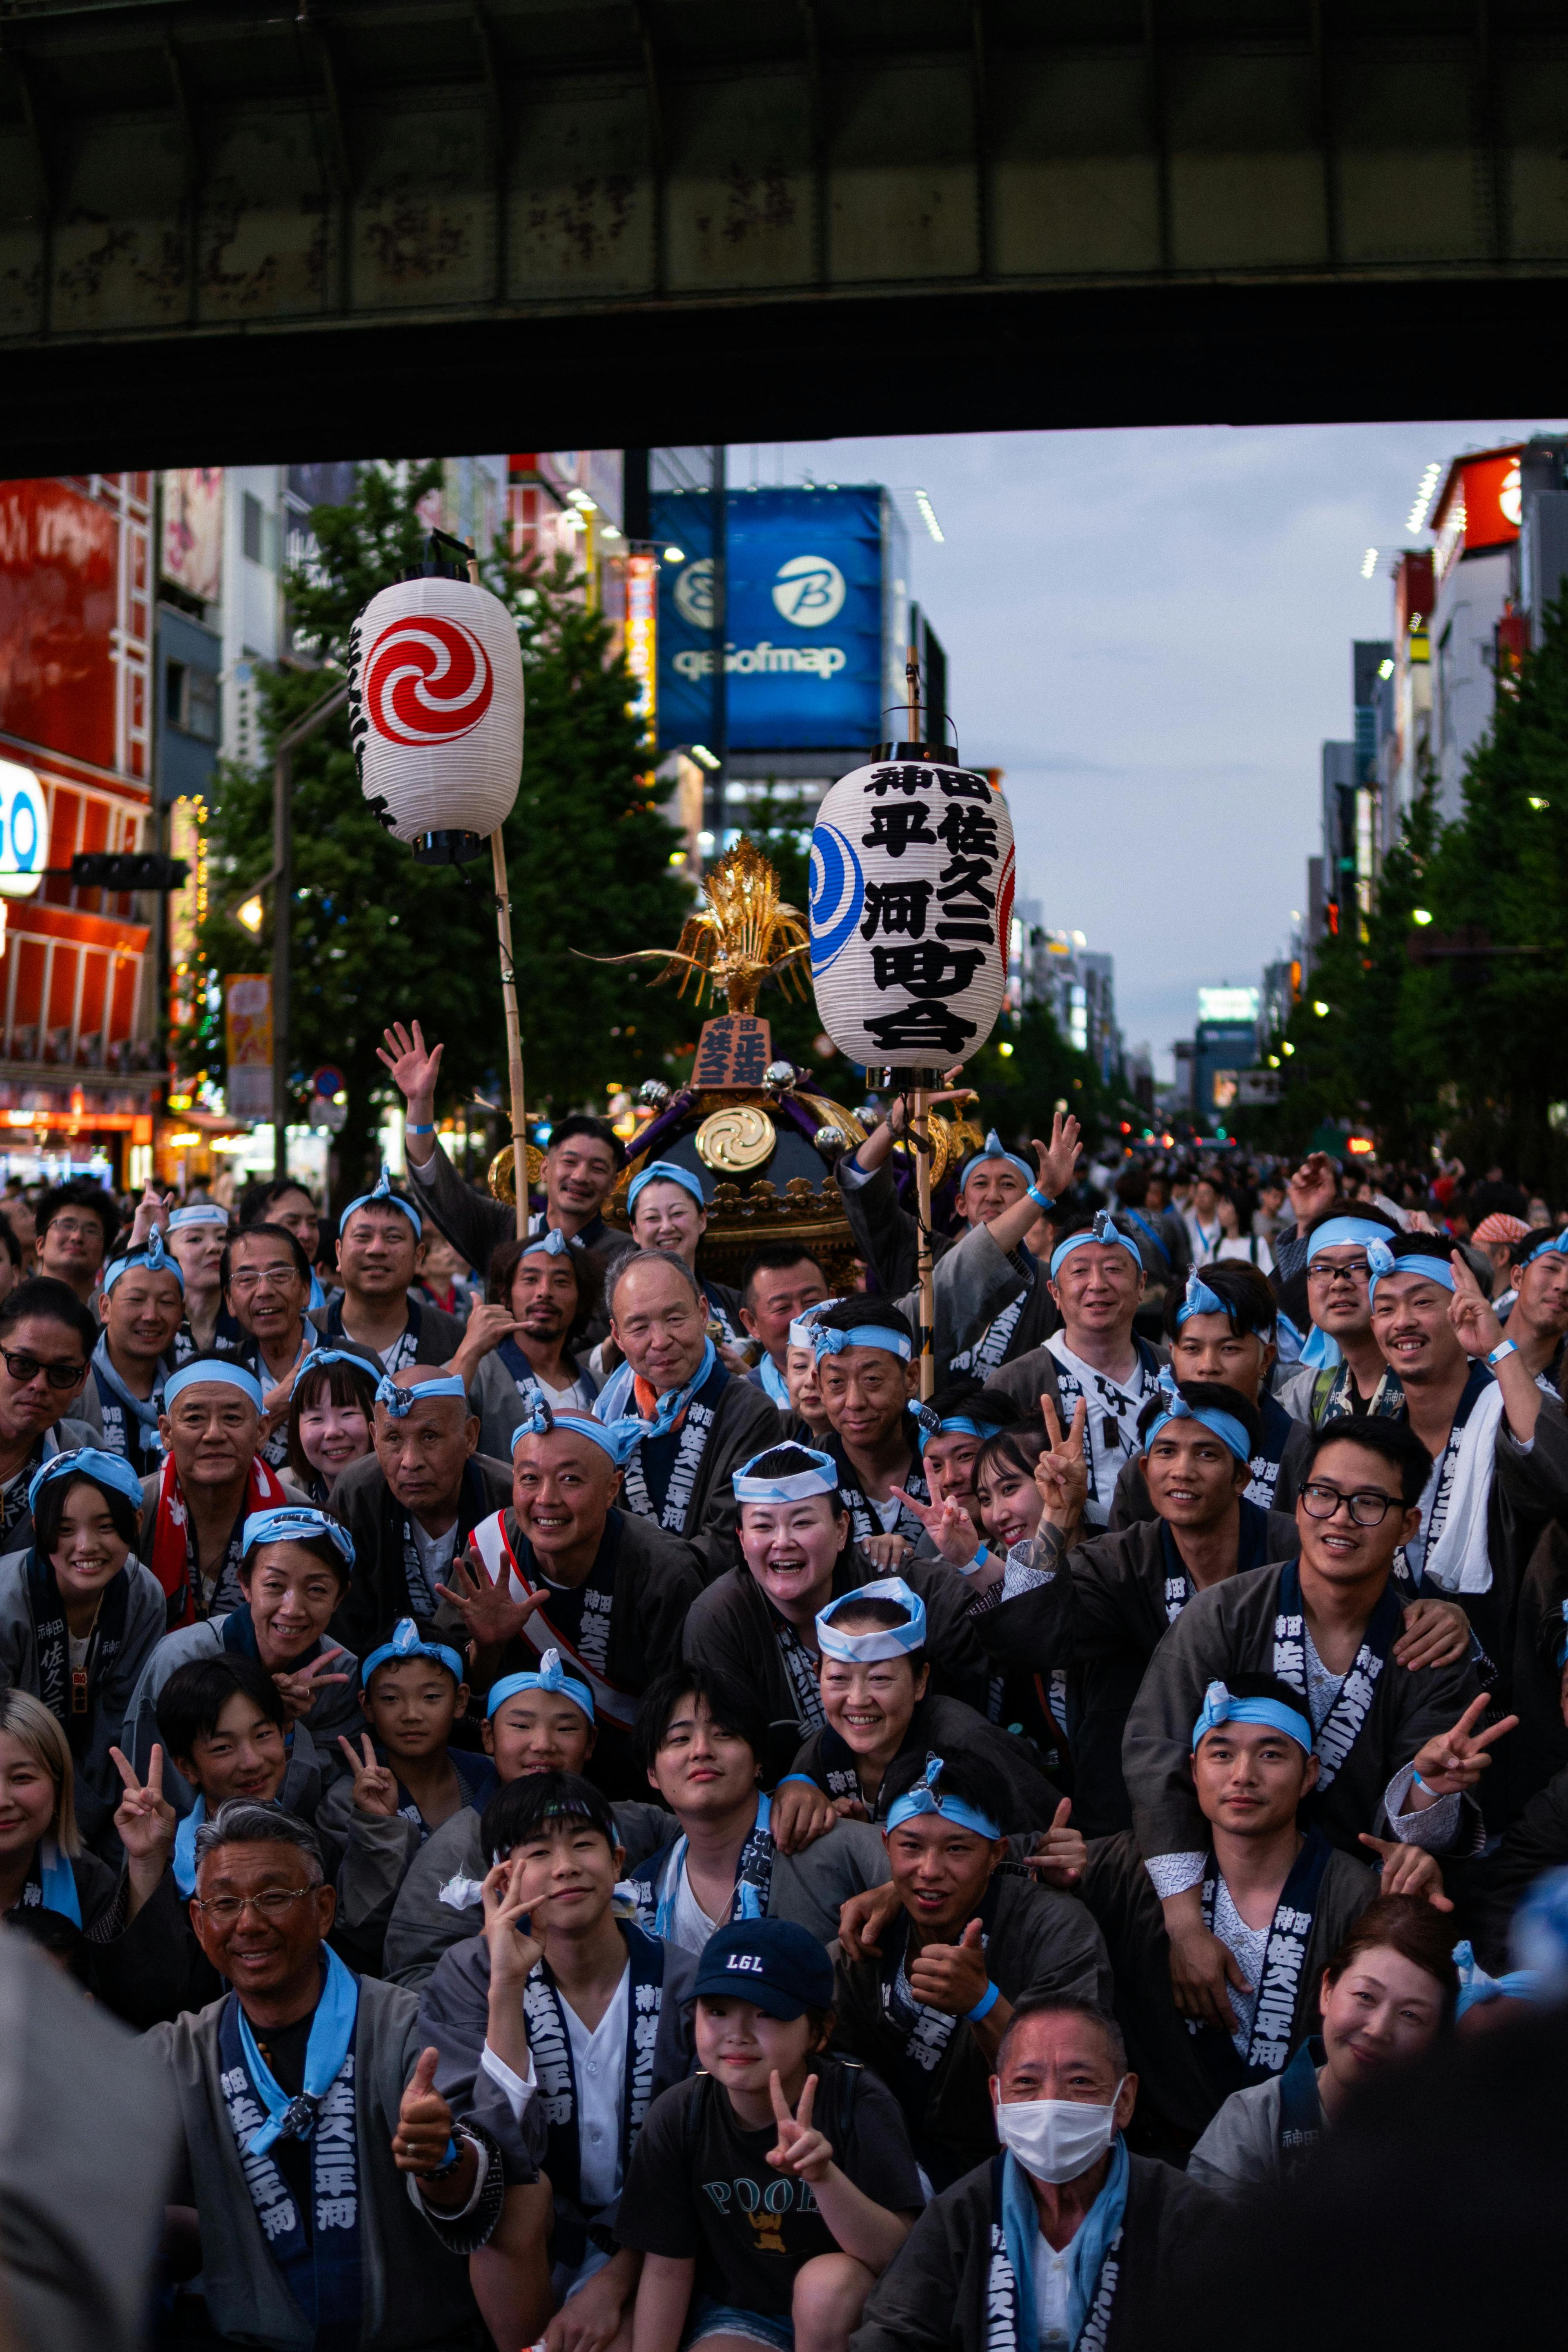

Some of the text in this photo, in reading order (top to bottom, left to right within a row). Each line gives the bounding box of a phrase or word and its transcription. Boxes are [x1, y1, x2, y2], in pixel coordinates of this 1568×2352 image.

[864, 764, 993, 804] 神田
[936, 802, 999, 945] 佐久二
[862, 939, 987, 1054] 町会
[1057, 1374, 1079, 1391] 神田
[689, 1402, 715, 1427] 神田
[662, 1424, 708, 1531] 佐久二平河
[1250, 1456, 1279, 1481] 神田
[584, 1588, 613, 1613] 神田
[38, 1618, 64, 1640] 神田
[1275, 1615, 1303, 1639] 神田
[1356, 1644, 1383, 1679] 神田
[826, 1768, 858, 1794] 神田
[1274, 1905, 1312, 1935] 神田
[726, 1954, 763, 1973] LGL
[1249, 1934, 1305, 2070] 佐久二平河
[314, 2081, 358, 2232] 佐久二平河
